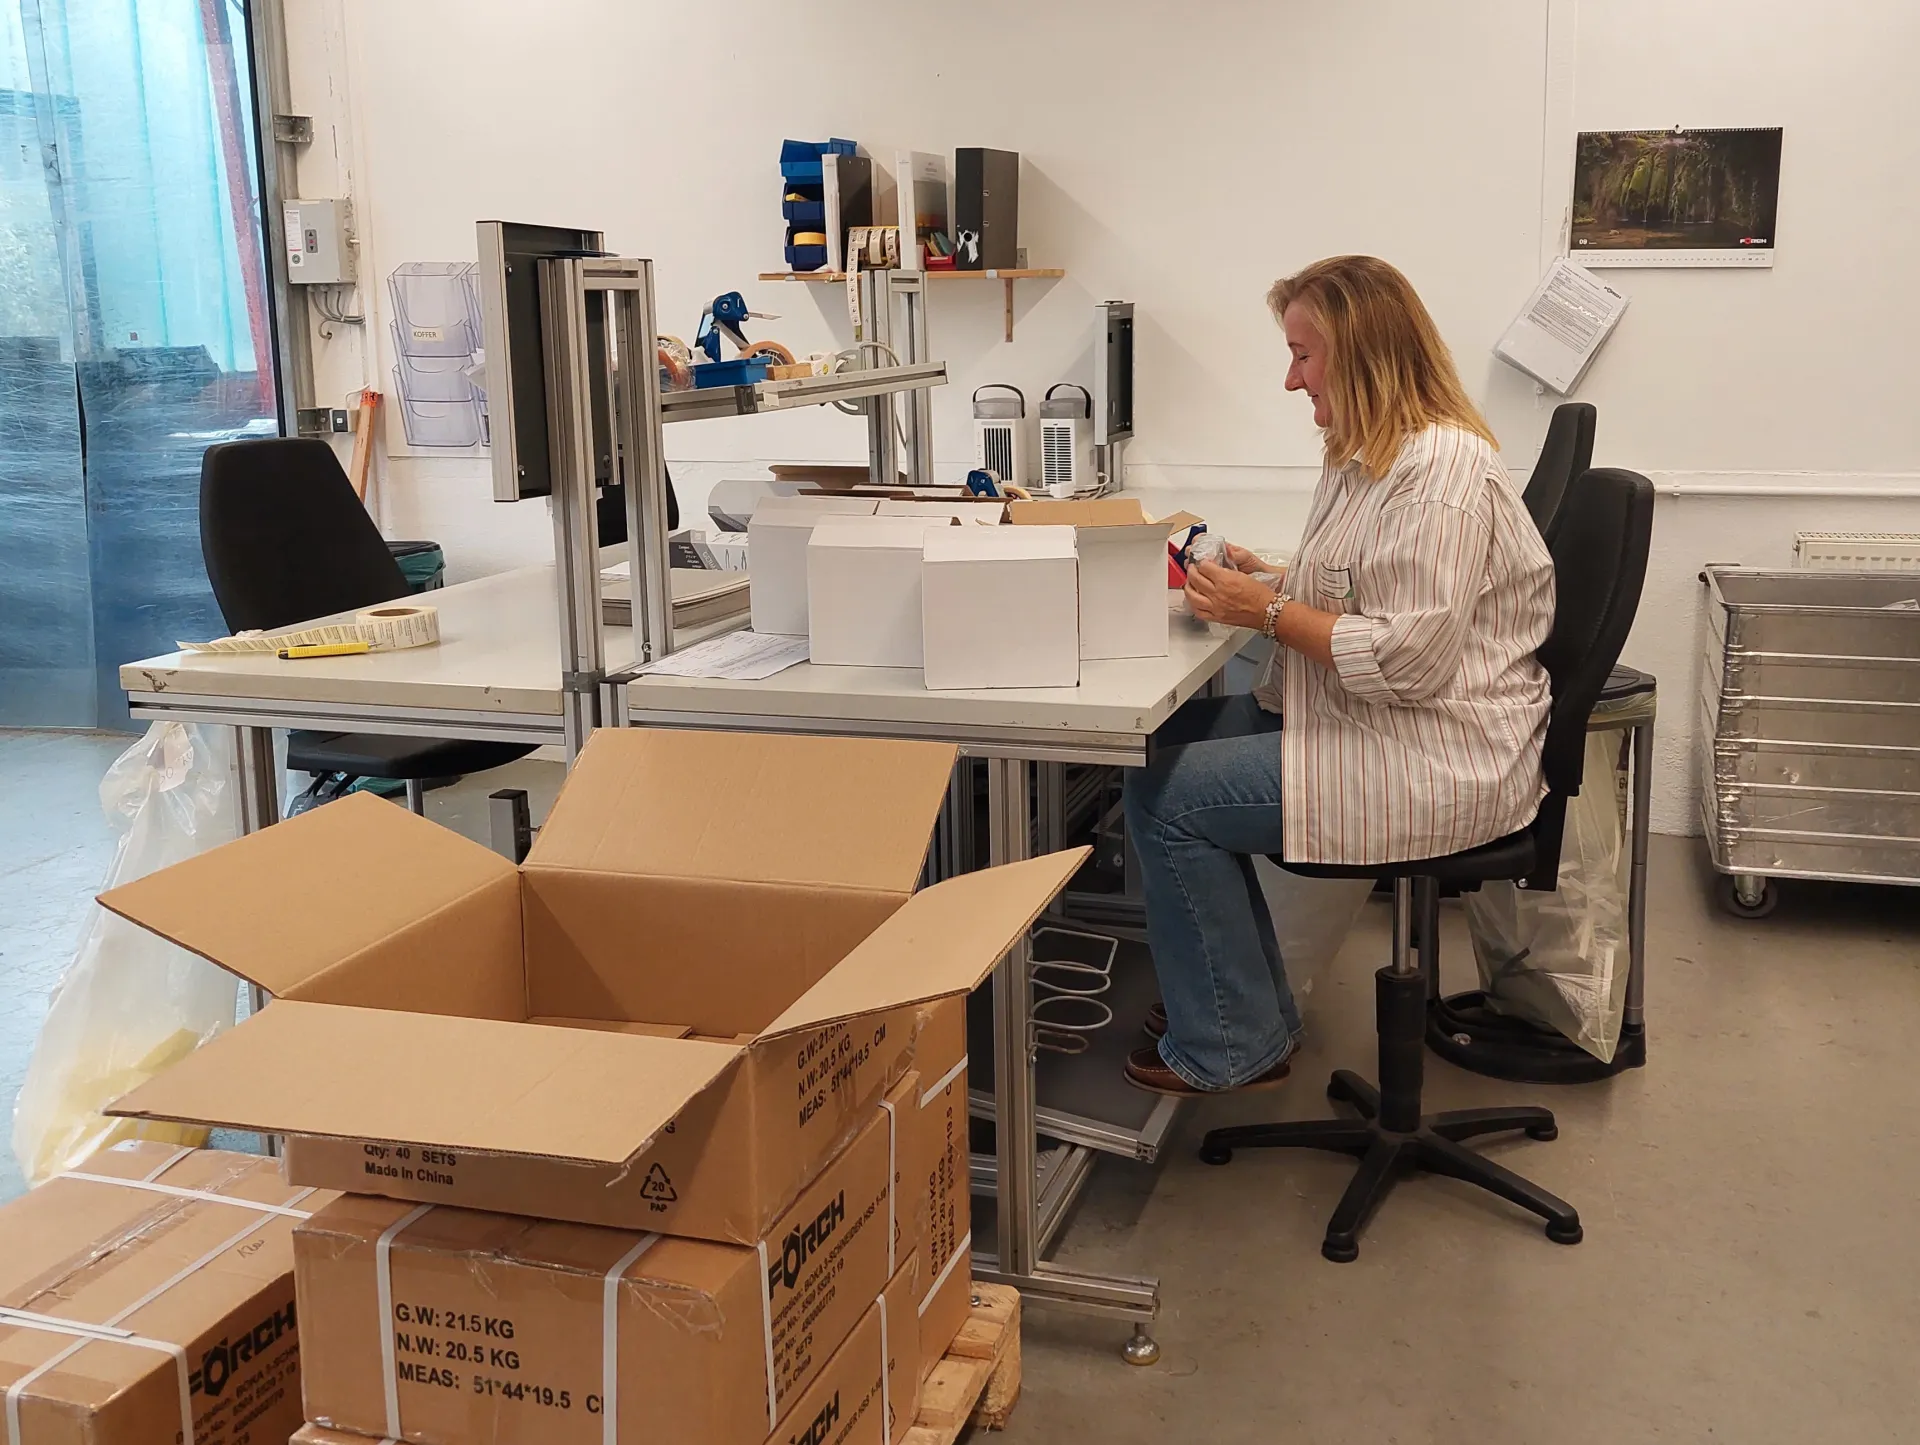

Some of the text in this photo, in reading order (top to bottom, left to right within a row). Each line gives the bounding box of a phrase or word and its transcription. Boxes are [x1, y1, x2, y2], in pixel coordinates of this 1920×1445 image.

[819, 1049, 836, 1079] 20.5
[838, 1033, 851, 1058] KG
[799, 1088, 827, 1129] MEAS:
[873, 1022, 887, 1048] CM
[363, 1143, 457, 1167] Qty: 40 SETS
[364, 1160, 399, 1178] Made
[416, 1168, 455, 1186] China
[651, 1180, 665, 1193] 20
[649, 1202, 668, 1213] PAP
[395, 1303, 440, 1328] G.W:
[397, 1333, 520, 1370] N.W: 20.5 KG
[398, 1361, 461, 1389] MEAS:
[586, 1394, 604, 1415] C
